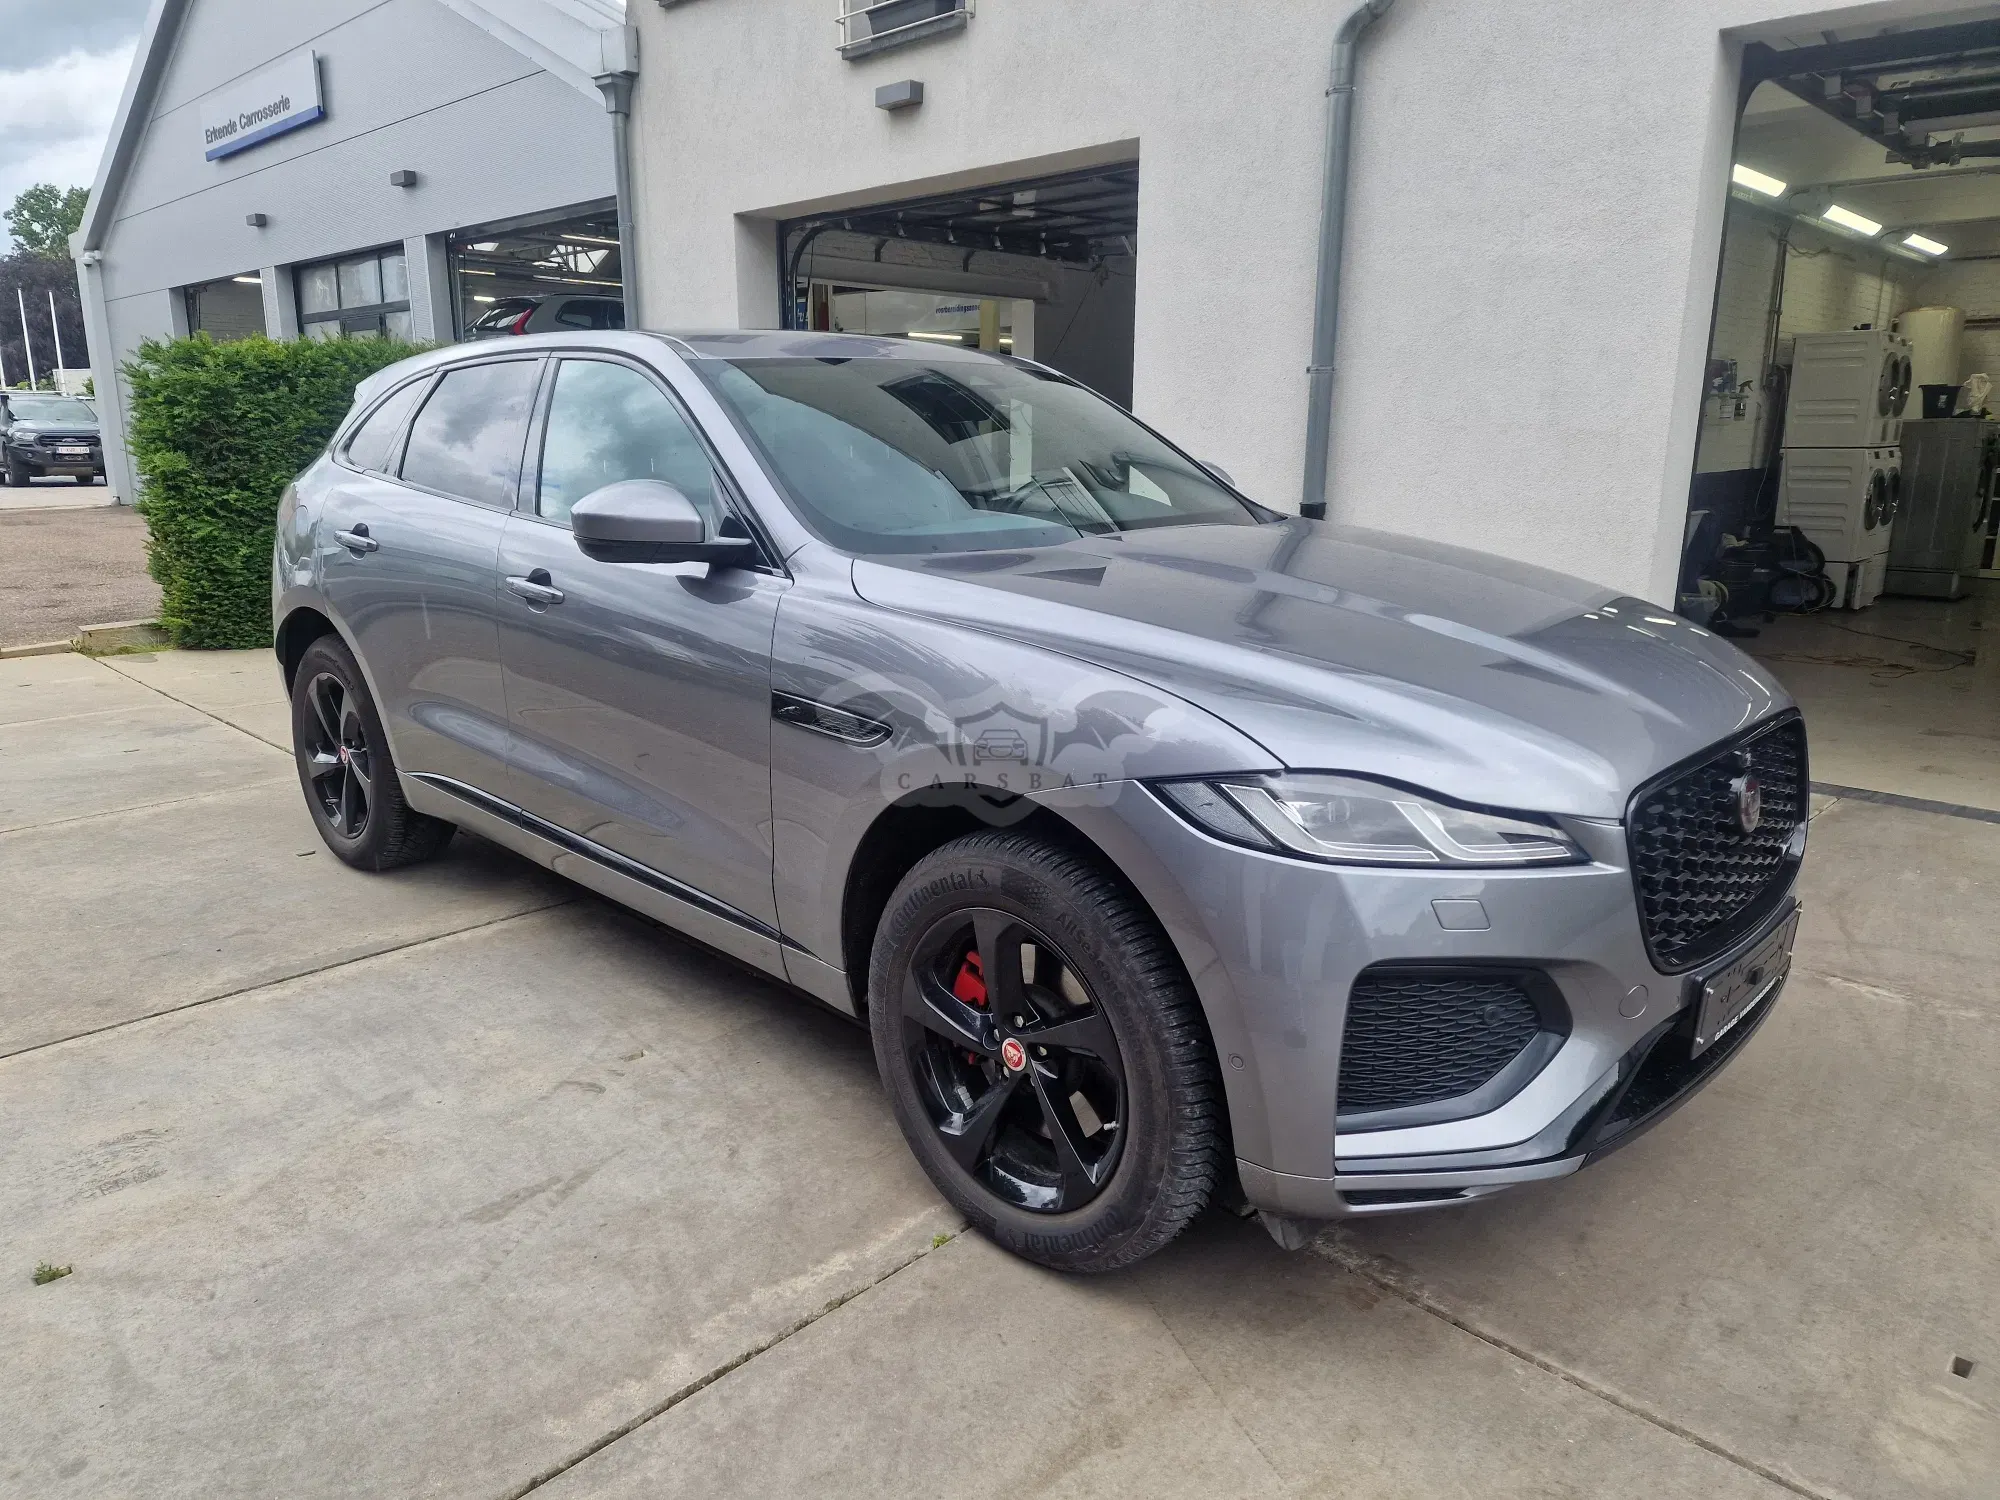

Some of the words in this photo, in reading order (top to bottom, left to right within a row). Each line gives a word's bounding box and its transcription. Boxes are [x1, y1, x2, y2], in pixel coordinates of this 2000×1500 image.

[205, 119, 238, 144] Erkende
[239, 95, 290, 130] Carrosserie
[891, 868, 976, 937] Continental
